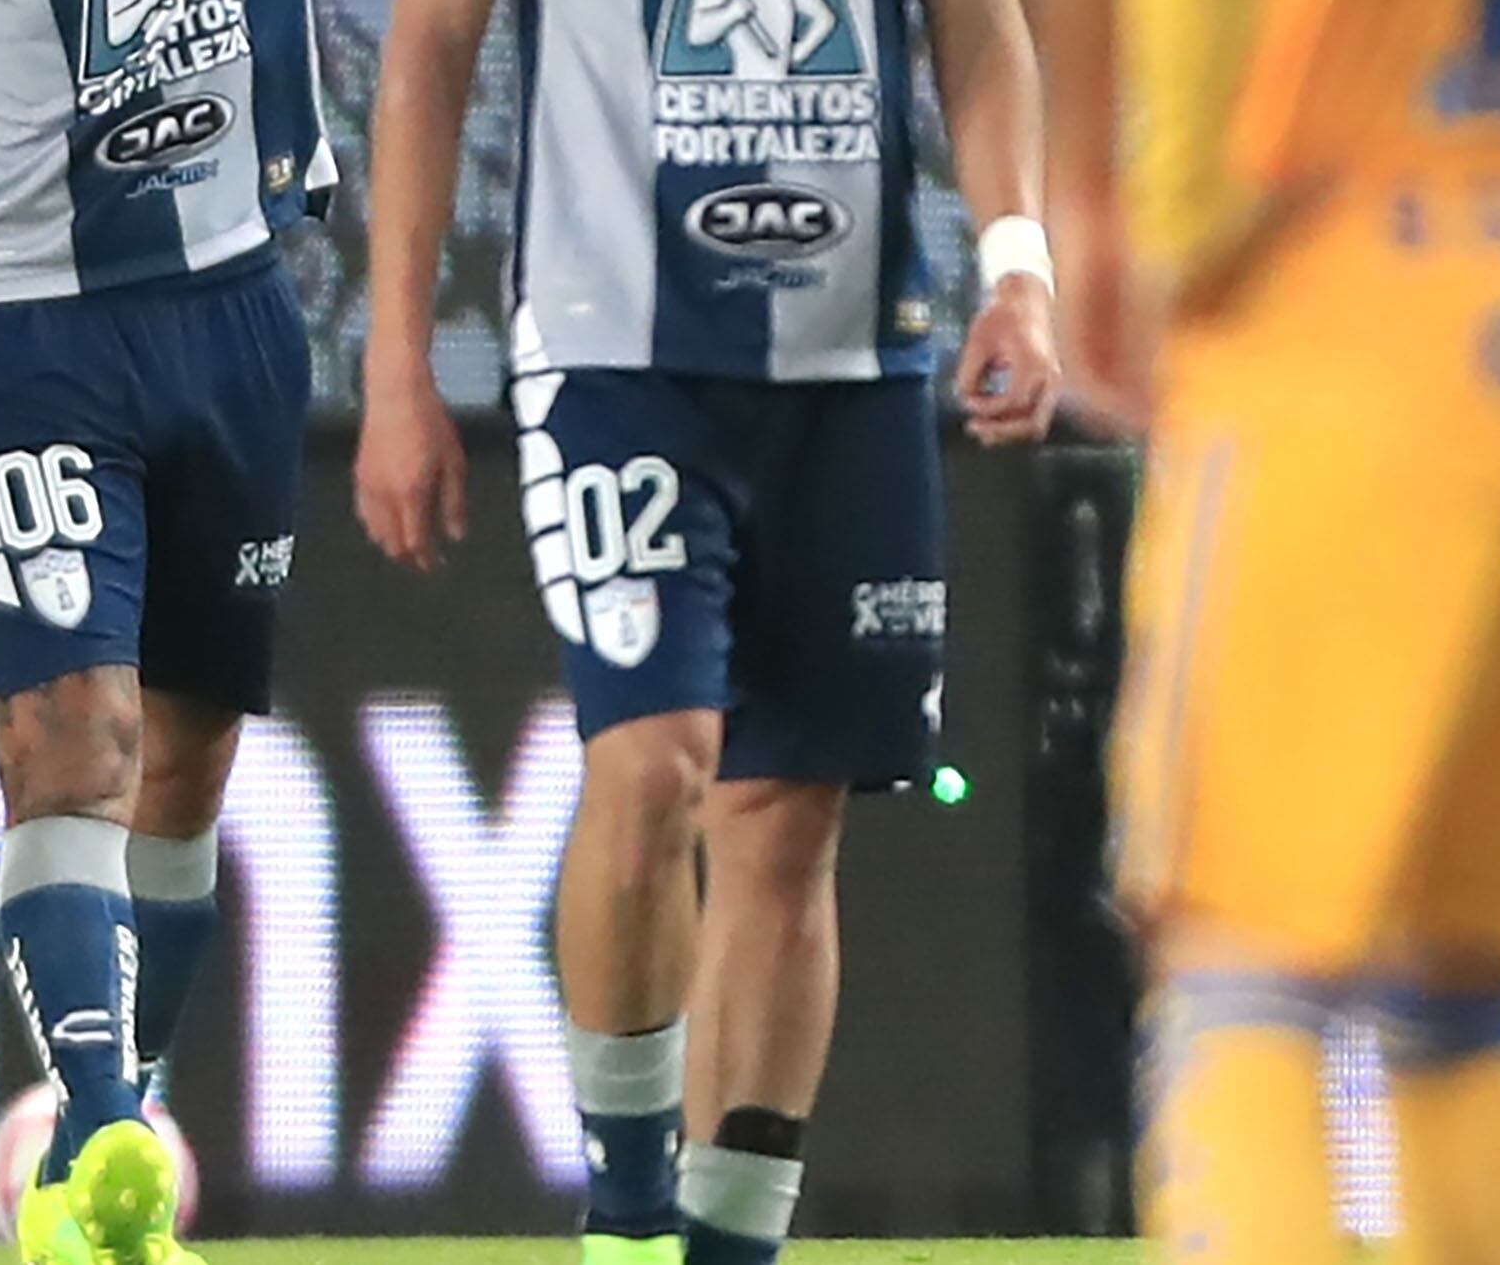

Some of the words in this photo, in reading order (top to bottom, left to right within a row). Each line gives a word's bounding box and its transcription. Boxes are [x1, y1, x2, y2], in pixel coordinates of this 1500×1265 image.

[657, 82, 876, 123] CEMENTOS
[118, 104, 213, 160] JAC
[653, 124, 881, 166] FORTALEZA
[710, 201, 826, 236] JAC
[565, 456, 687, 584] 02
